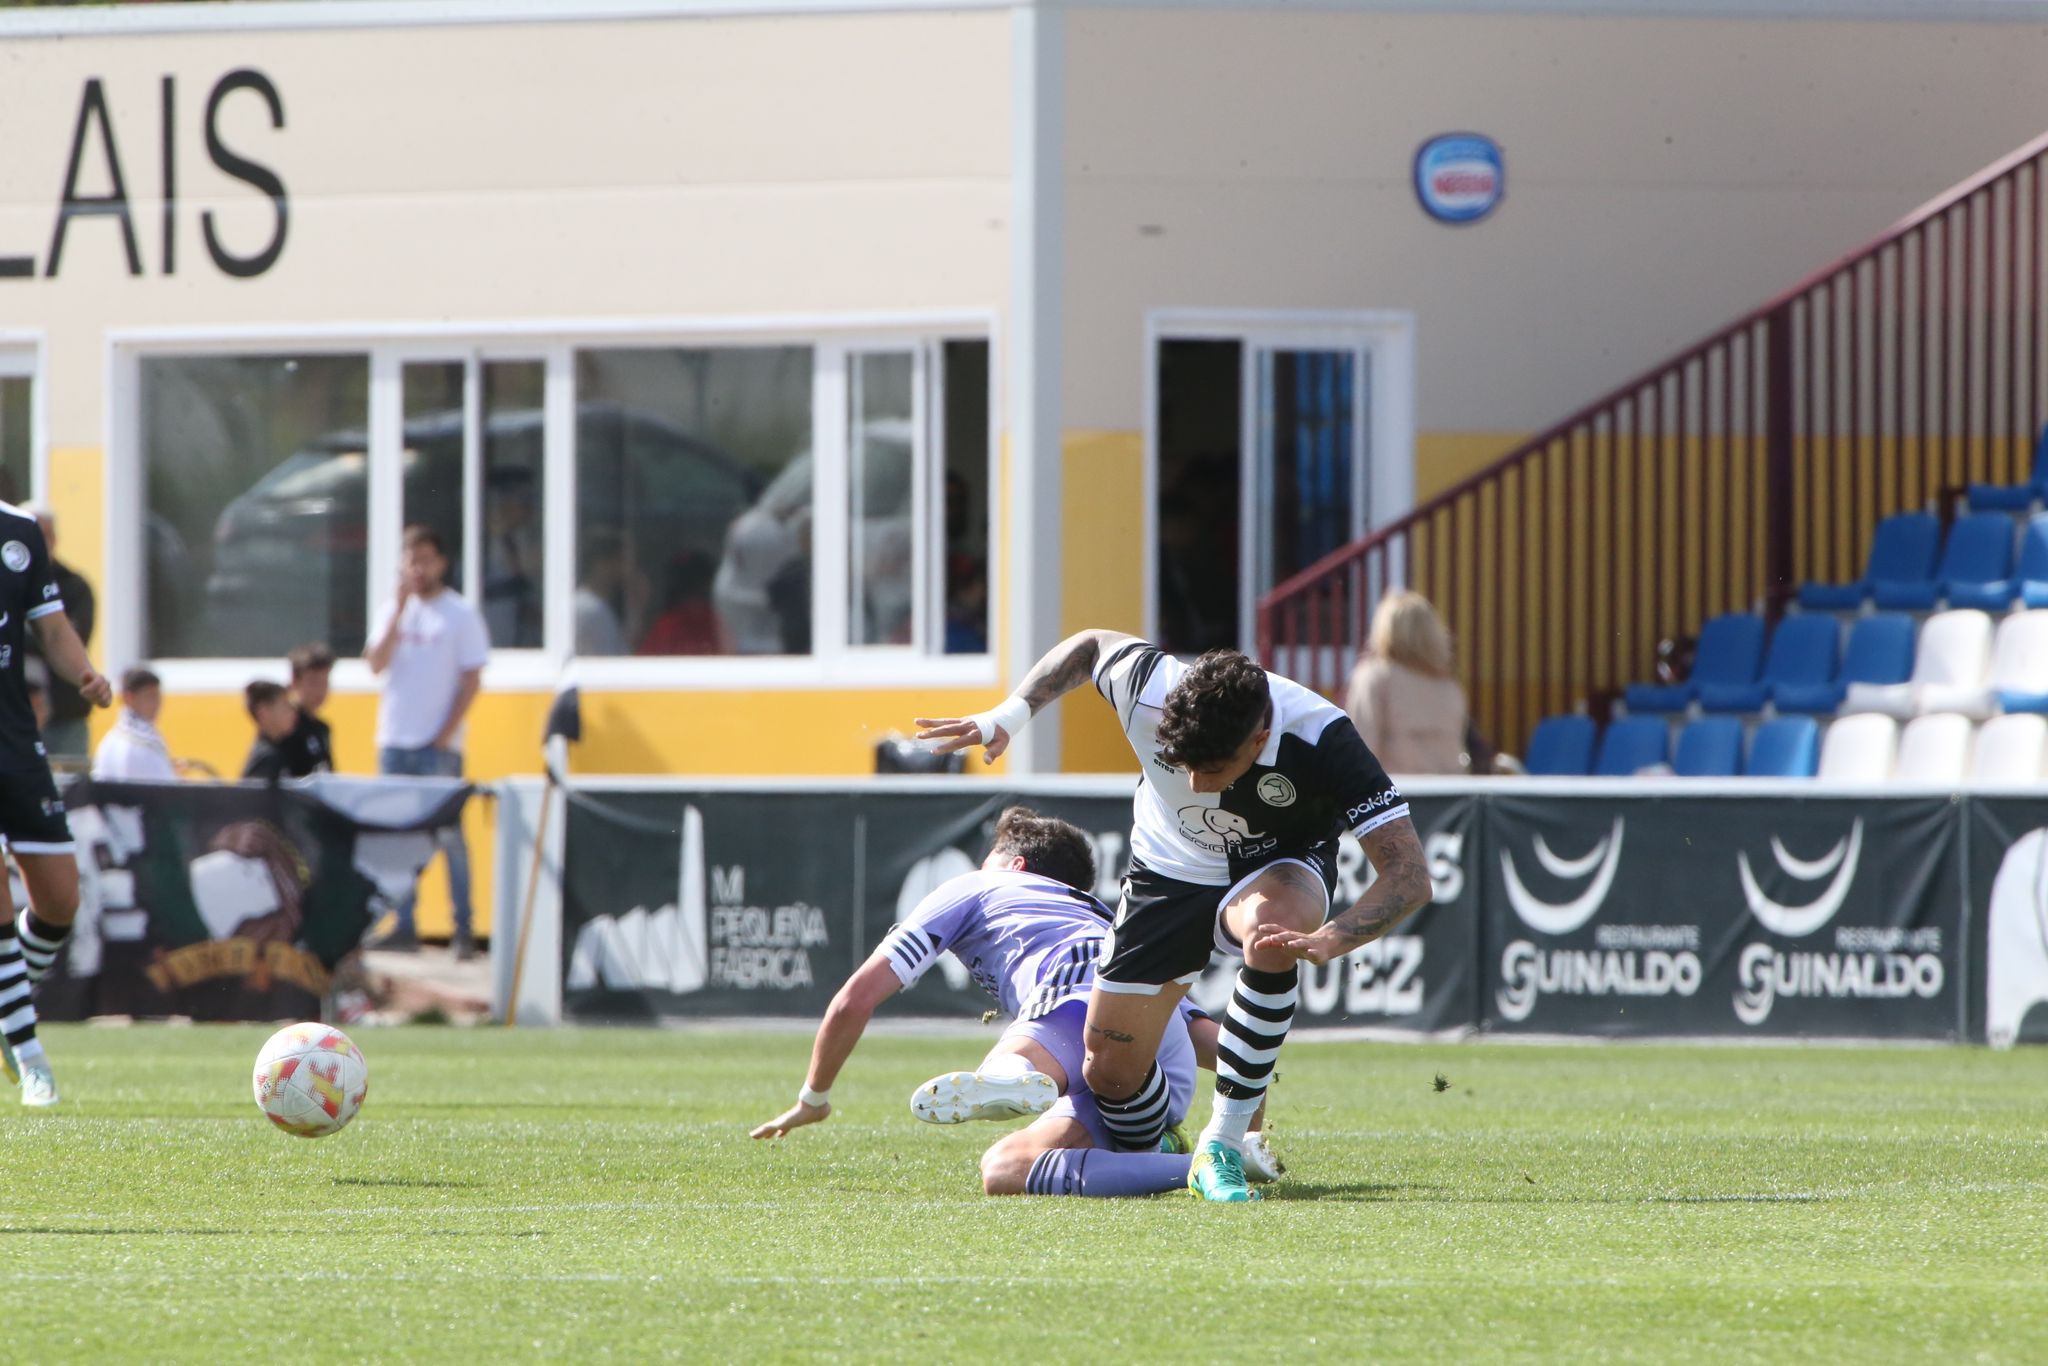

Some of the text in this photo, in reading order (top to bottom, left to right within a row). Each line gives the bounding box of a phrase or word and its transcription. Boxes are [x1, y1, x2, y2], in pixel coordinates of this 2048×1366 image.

[1595, 924, 1699, 950] RESTAURANTE
[1495, 939, 1702, 1022] GUINALDO
[1732, 941, 1944, 1025] GUINALDO
